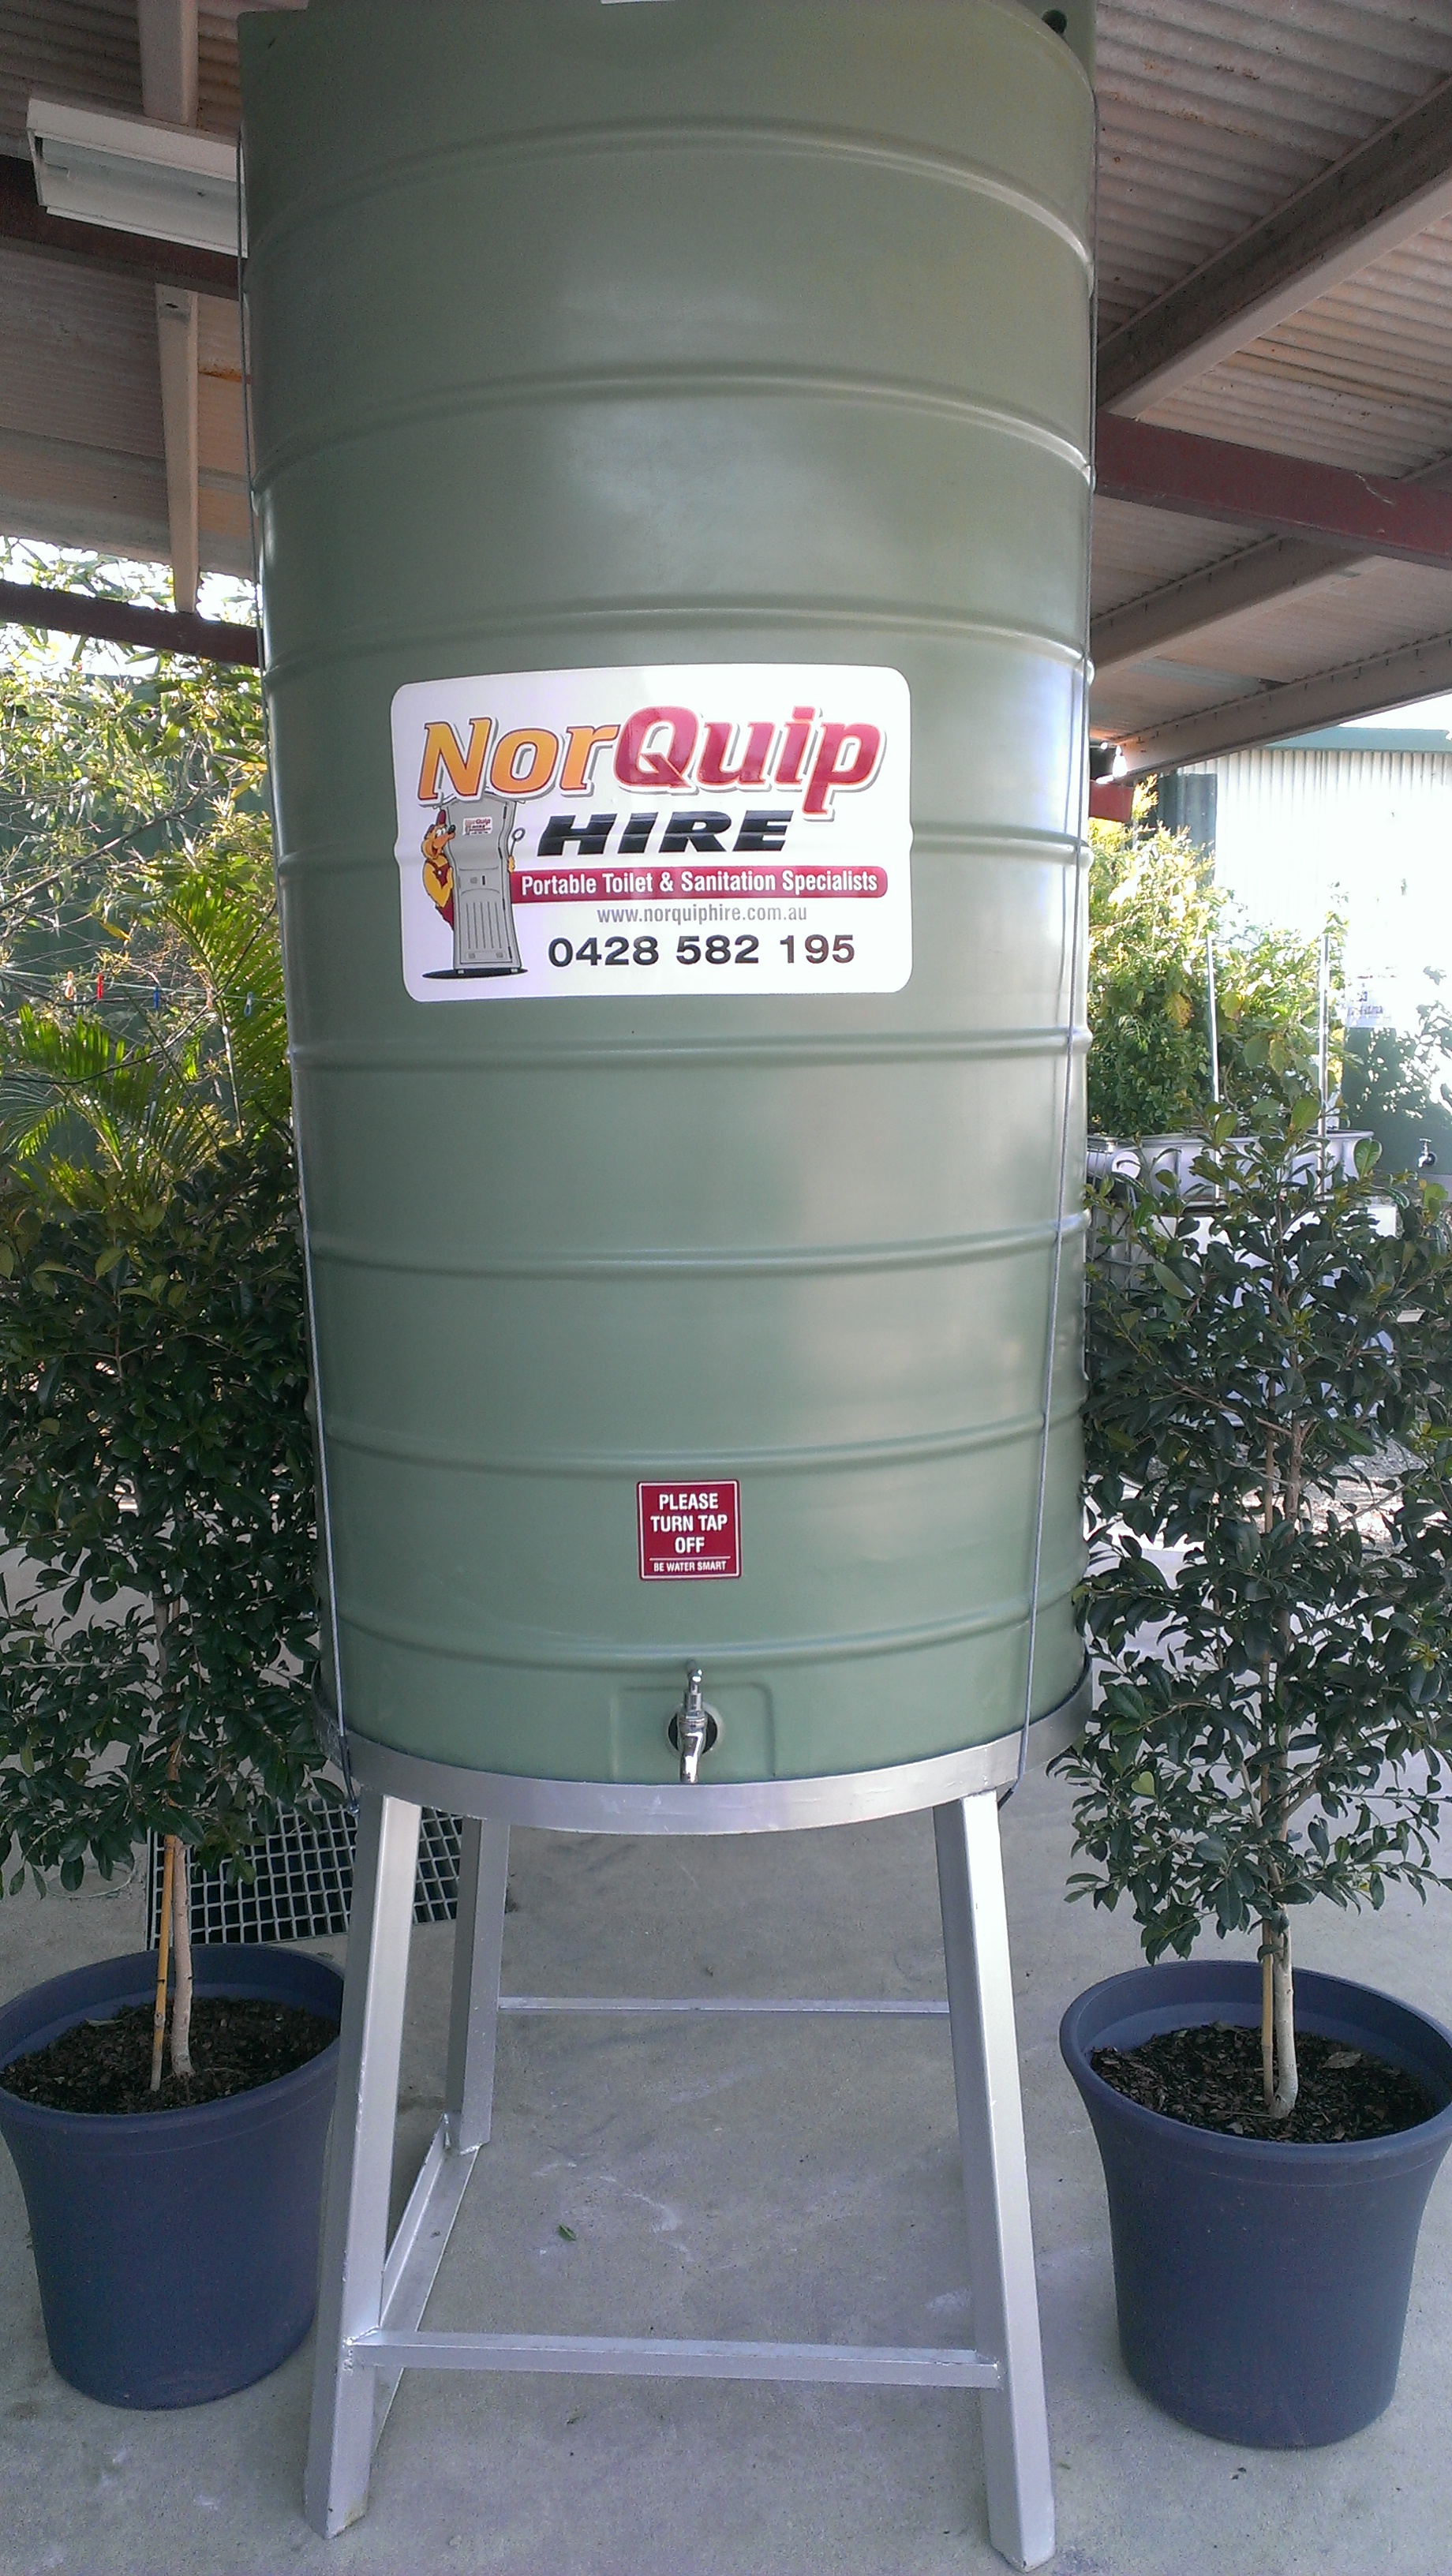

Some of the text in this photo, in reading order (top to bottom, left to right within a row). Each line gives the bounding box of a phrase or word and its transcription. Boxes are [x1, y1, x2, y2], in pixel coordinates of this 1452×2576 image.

[417, 706, 885, 820] NorQuip
[537, 810, 794, 856] HIRE
[521, 871, 878, 896] Portable Toilet & Sanitation Specialists
[597, 903, 807, 926] www.norquiphire.com.au
[548, 934, 855, 967] 0428 582 195
[659, 1492, 719, 1511] PLEASE
[649, 1514, 728, 1533] TURN TAP
[675, 1537, 705, 1554] OFF
[653, 1560, 726, 1572] BE WATER SMART
